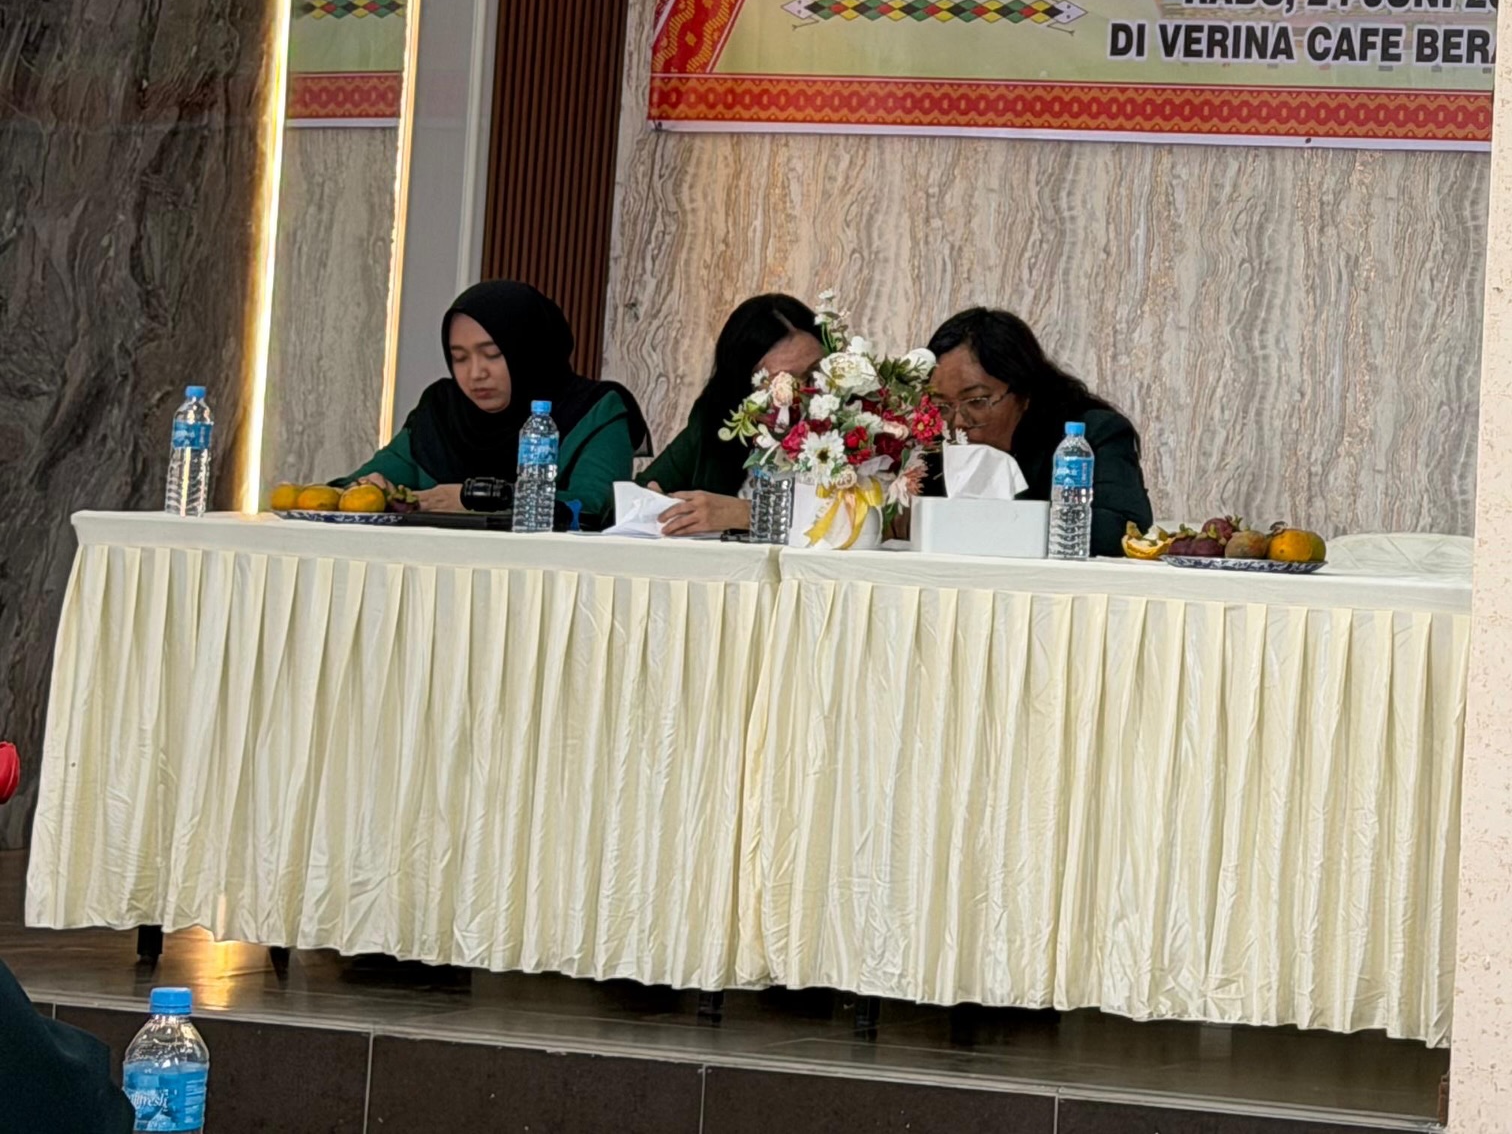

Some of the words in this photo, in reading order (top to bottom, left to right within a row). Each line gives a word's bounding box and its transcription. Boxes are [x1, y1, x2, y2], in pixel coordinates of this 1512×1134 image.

[1110, 23, 1146, 56] DI
[1158, 24, 1295, 60] VERINA
[1307, 26, 1403, 61] CAFE
[1415, 28, 1496, 64] BER
